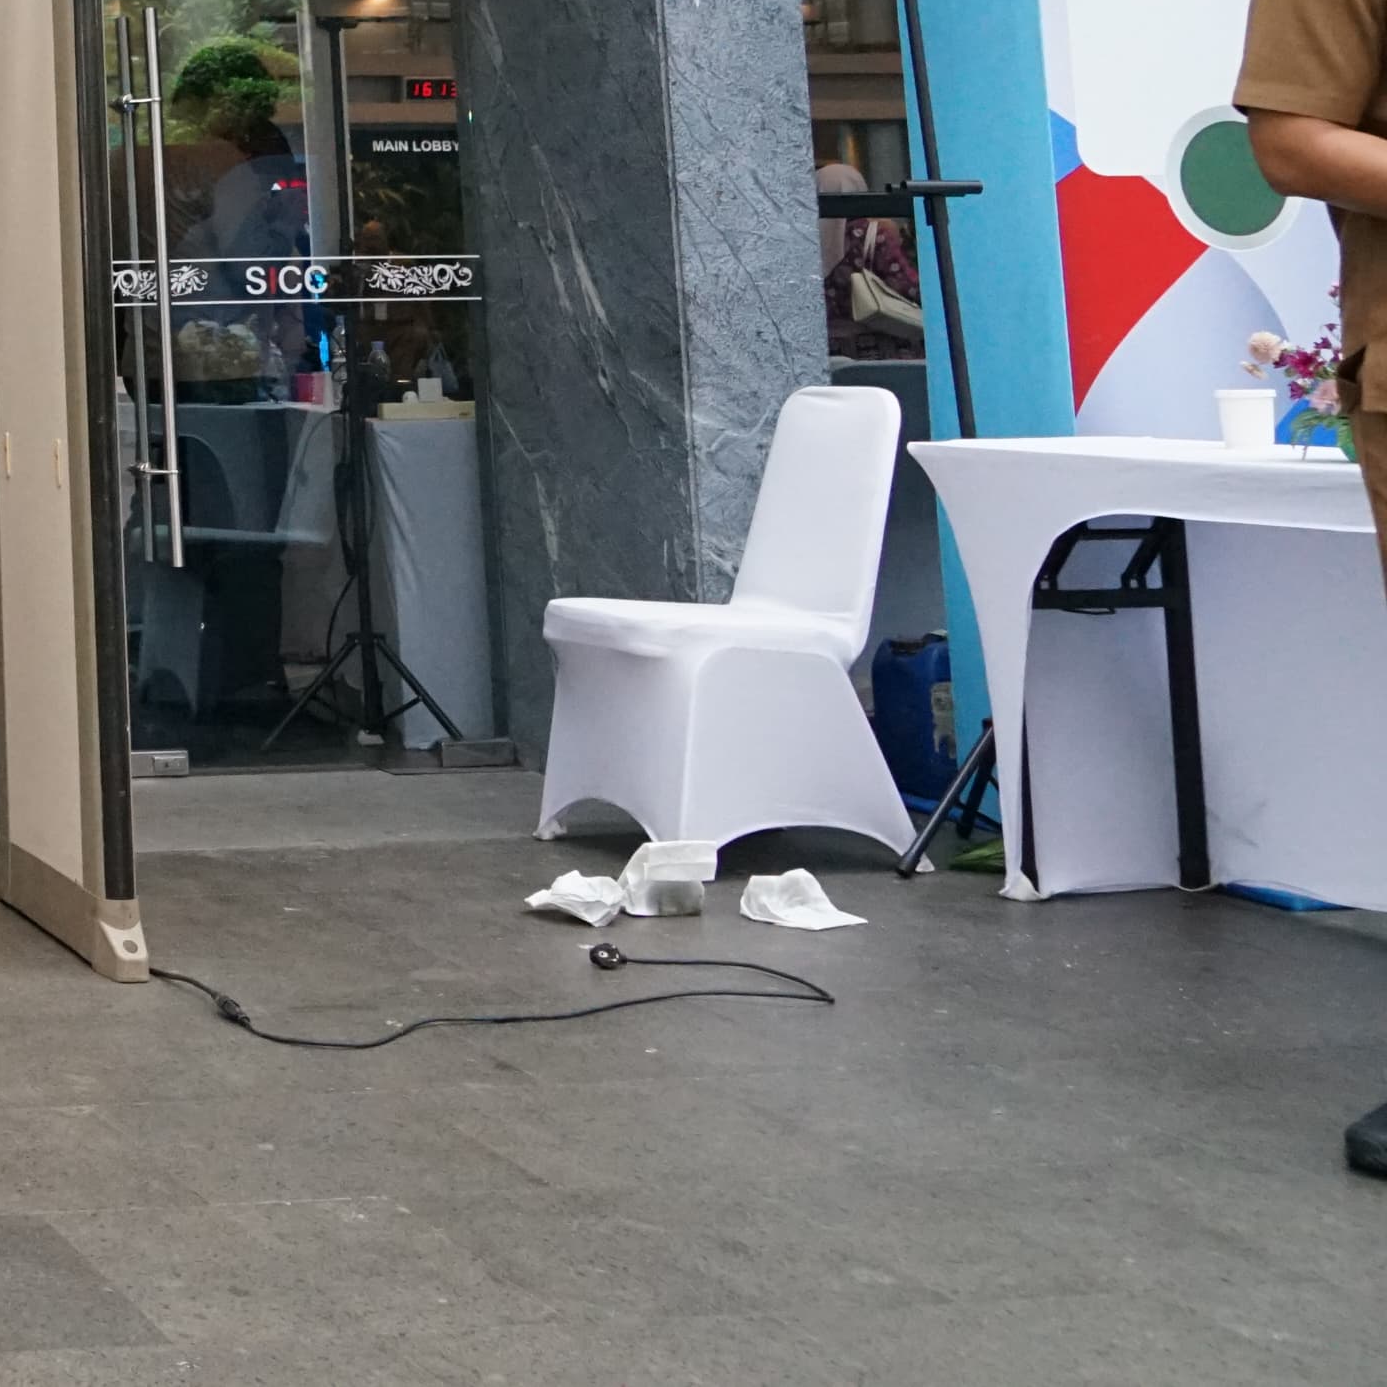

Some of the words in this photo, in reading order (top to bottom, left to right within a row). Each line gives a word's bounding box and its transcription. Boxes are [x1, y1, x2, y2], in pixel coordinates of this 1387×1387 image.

[371, 139, 409, 152] MAIN
[411, 139, 460, 152] LOBBY
[245, 265, 329, 296] SICC
